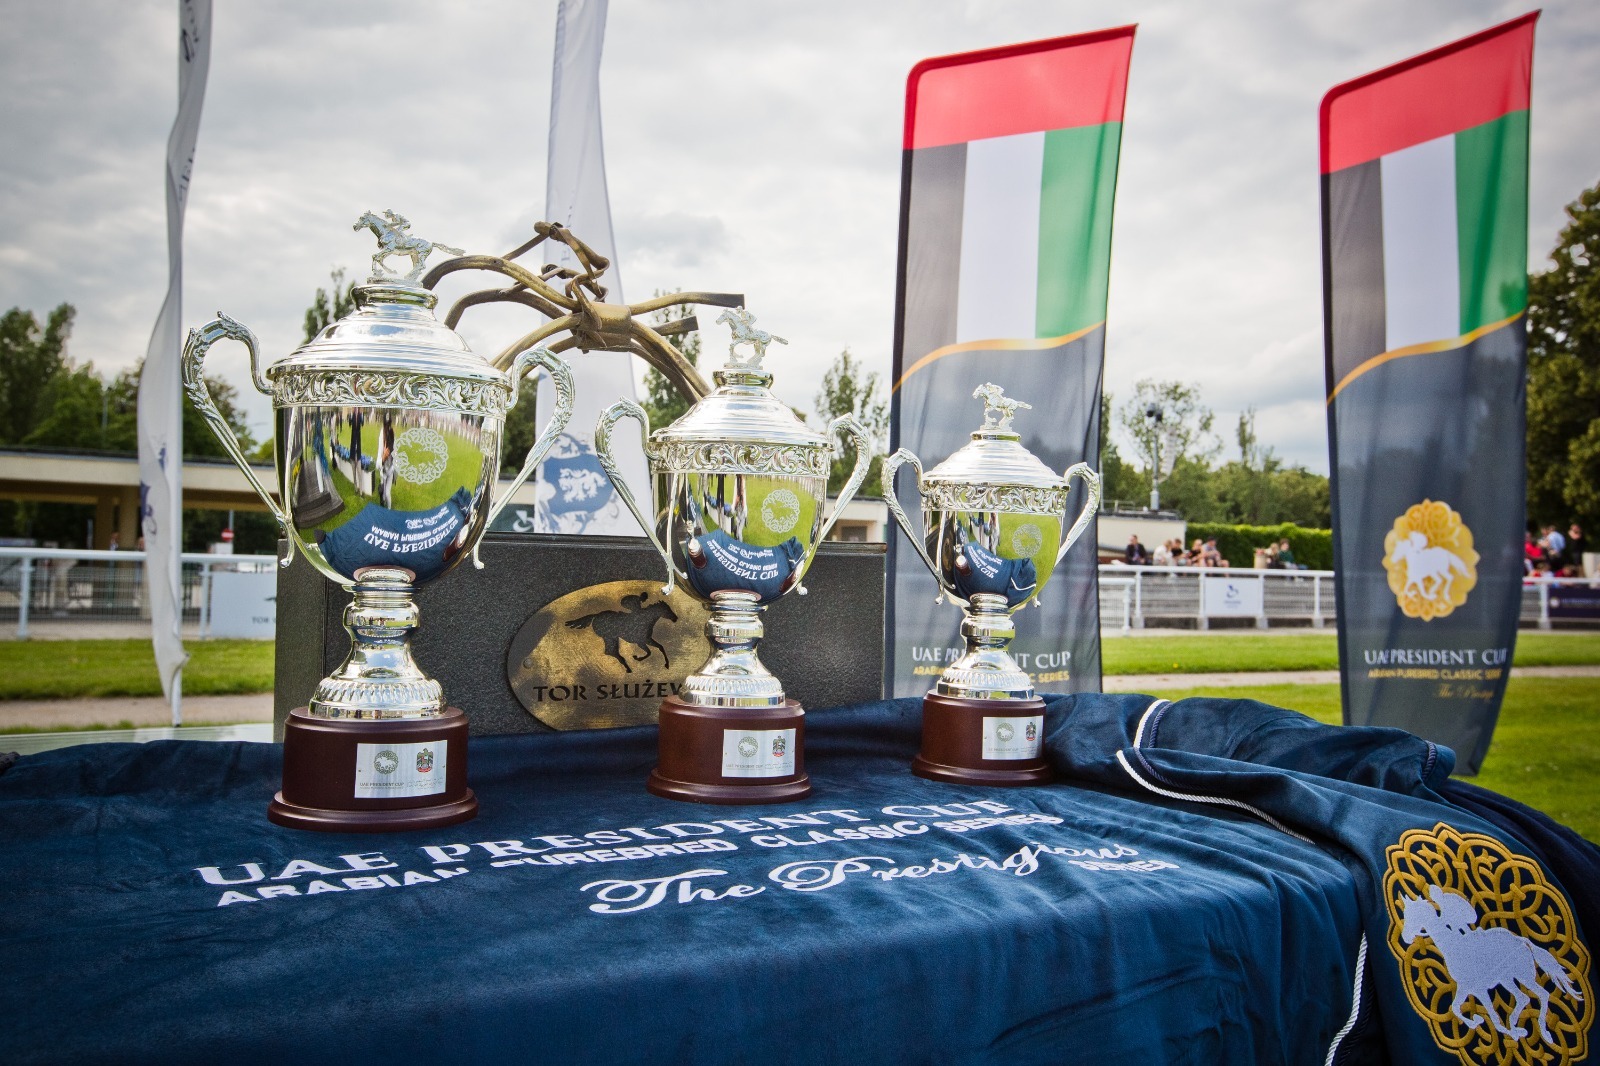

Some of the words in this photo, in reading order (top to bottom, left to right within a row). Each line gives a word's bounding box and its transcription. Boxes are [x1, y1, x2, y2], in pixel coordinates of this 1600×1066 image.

[912, 646, 942, 662] UAE
[1035, 650, 1071, 669] CUP
[1390, 648, 1477, 665] PRESIDENT
[912, 665, 946, 676] ARAB
[1037, 670, 1070, 683] SERIES
[533, 686, 587, 701] TOR
[194, 851, 399, 885] UAE
[421, 809, 870, 864] PRESIDENT
[881, 800, 1014, 818] CUP
[217, 867, 469, 907] ARABIAN
[751, 820, 930, 848] CLASSIC
[933, 814, 1065, 832] SERIES
[580, 868, 765, 914] The
[768, 841, 1139, 892] Prestigious
